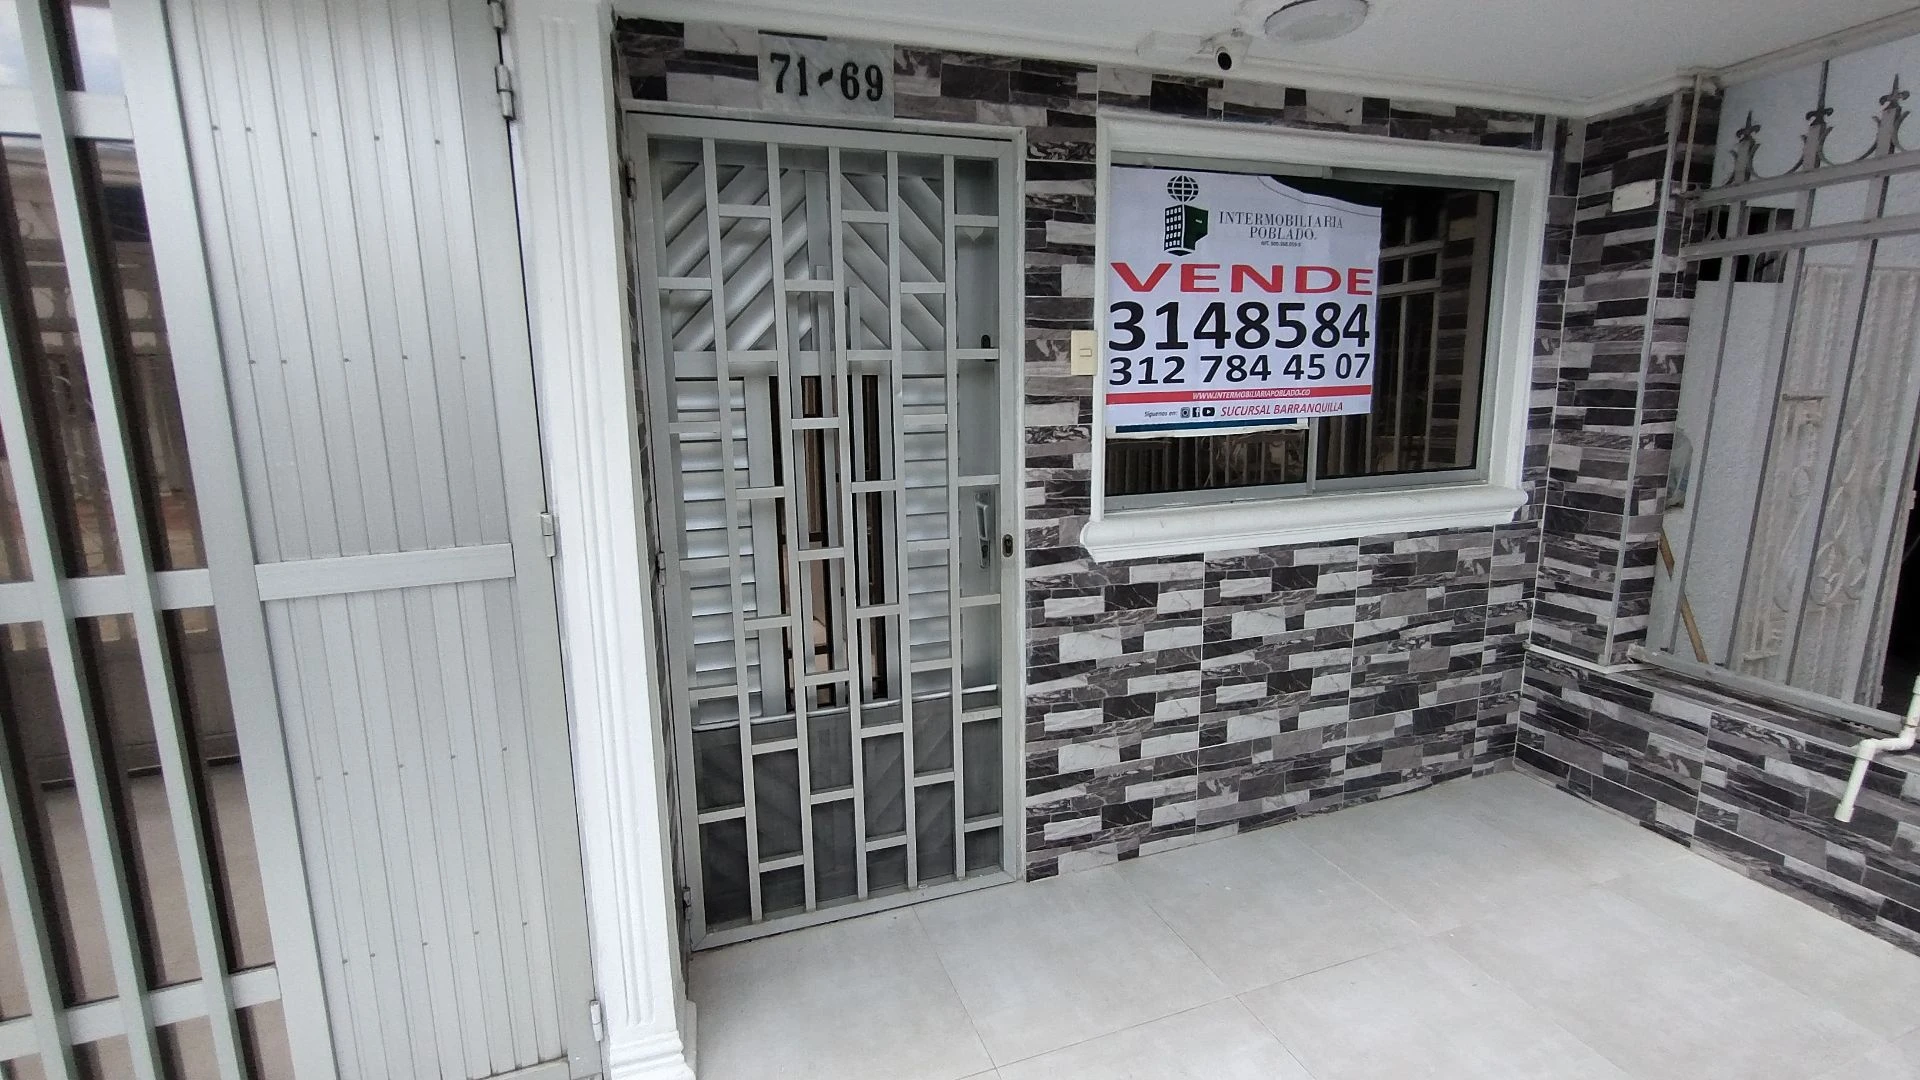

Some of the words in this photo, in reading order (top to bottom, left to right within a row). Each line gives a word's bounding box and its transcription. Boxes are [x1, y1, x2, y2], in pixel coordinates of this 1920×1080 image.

[770, 52, 883, 102] 71-69
[1219, 210, 1343, 229] INTERMOBILIARIA
[1110, 262, 1374, 295] VENDE
[1108, 301, 1370, 351] 3148584
[1109, 356, 1185, 386] 312
[1200, 354, 1272, 383] 784
[1283, 353, 1326, 381] 45
[1335, 353, 1371, 380] 07
[1220, 404, 1272, 417] SUCURSAL
[1273, 401, 1344, 415] BARRANQUILLA
